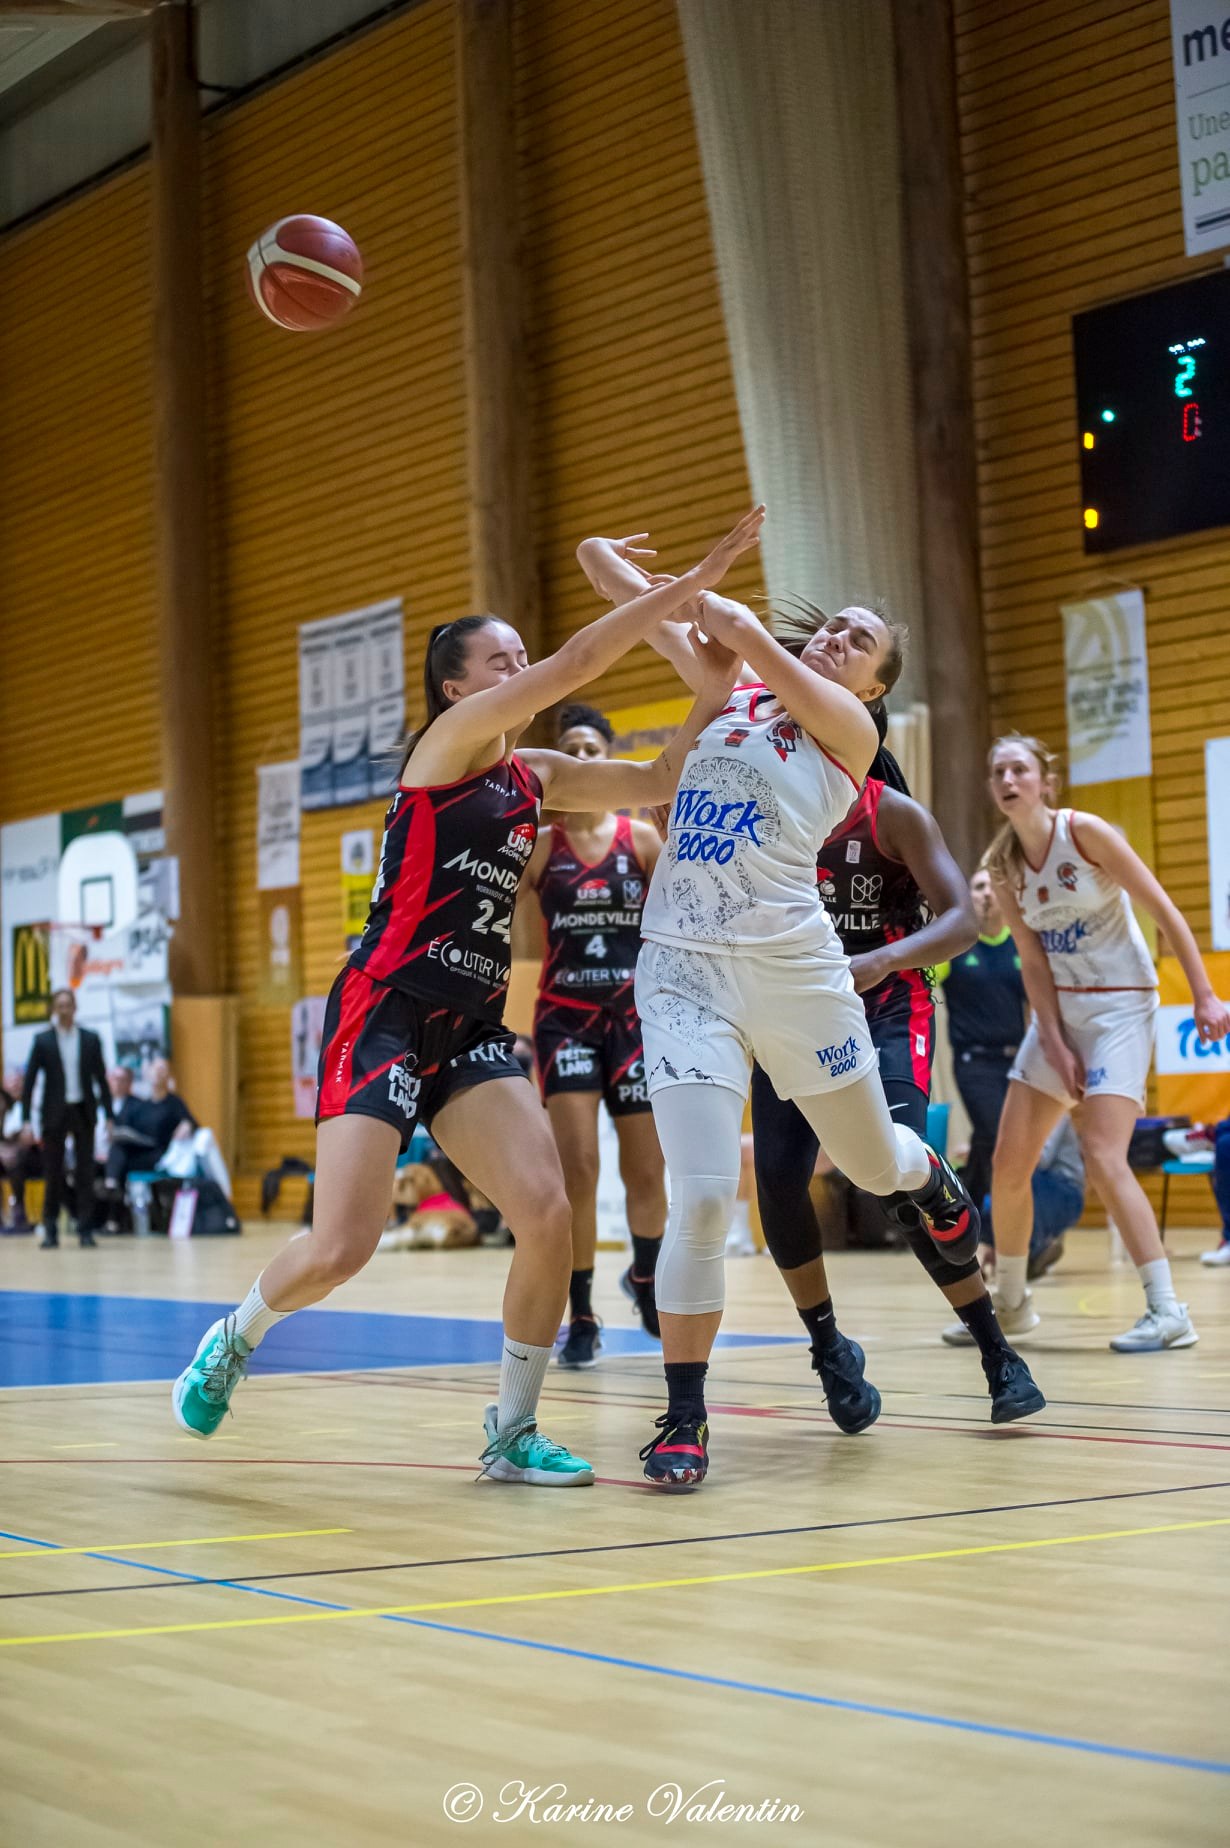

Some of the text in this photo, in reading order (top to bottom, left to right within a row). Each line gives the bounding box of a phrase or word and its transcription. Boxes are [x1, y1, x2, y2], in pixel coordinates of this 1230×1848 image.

[1175, 355, 1196, 398] 2
[674, 790, 767, 847] Work
[677, 831, 735, 866] 2000
[471, 898, 512, 945] 24
[552, 912, 640, 930] MONDEVILLE
[584, 934, 608, 959] 4
[335, 1041, 350, 1083] TARMAK
[816, 1036, 861, 1066] Work
[830, 1055, 857, 1078] 2000
